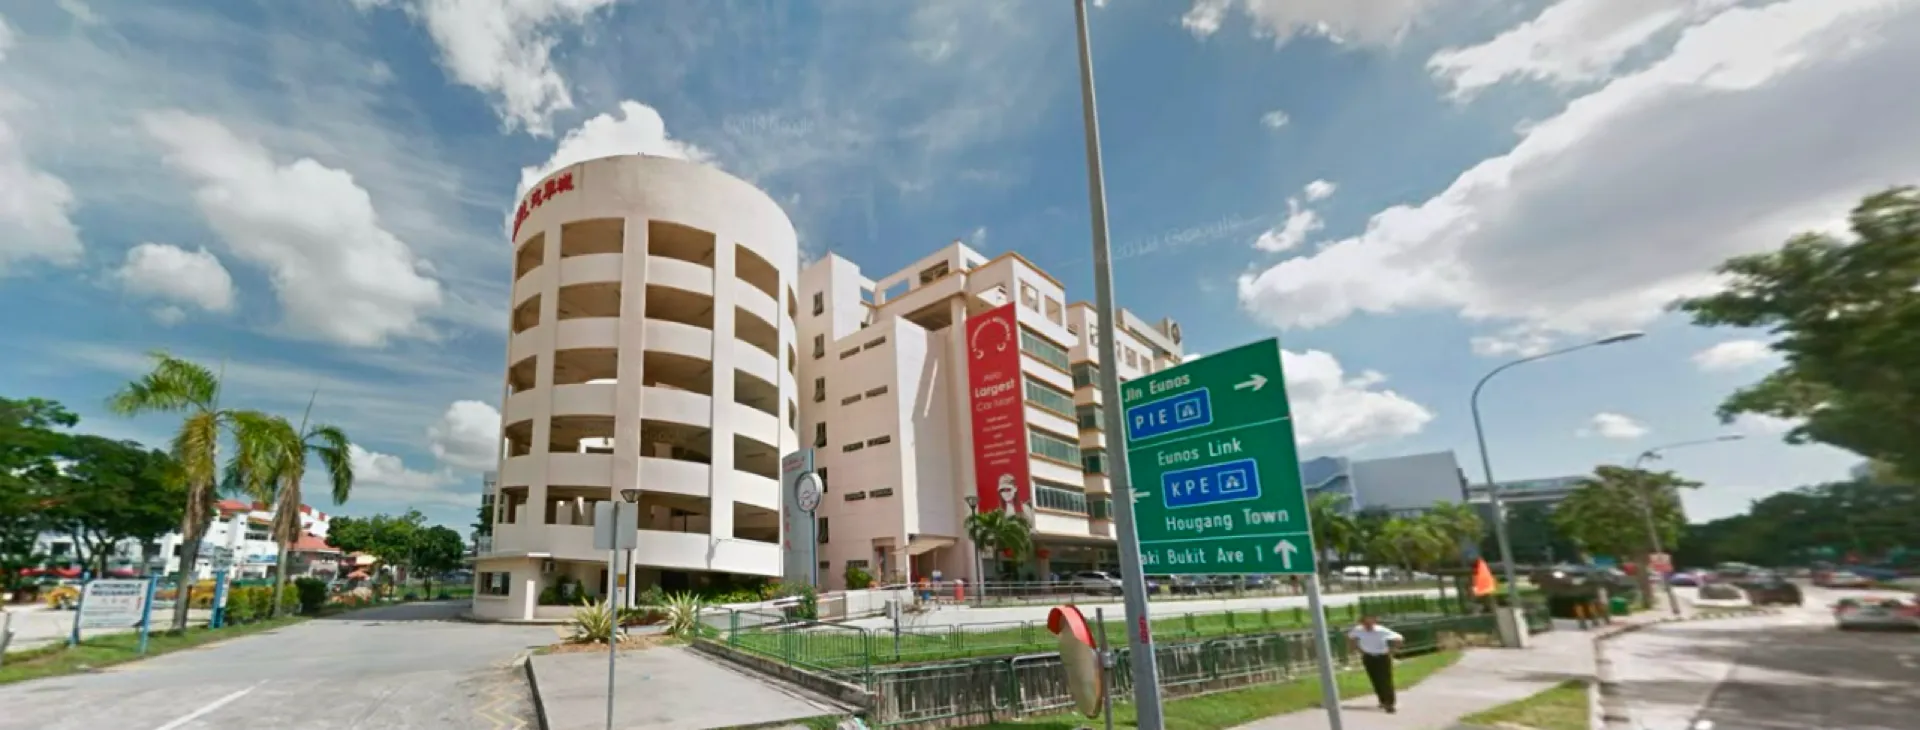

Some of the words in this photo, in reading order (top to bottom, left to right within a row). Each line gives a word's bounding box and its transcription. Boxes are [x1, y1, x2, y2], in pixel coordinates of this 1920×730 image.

[974, 378, 1015, 398] Largest
[1124, 387, 1143, 402] Jln
[1149, 374, 1191, 395] Eunos
[1135, 408, 1168, 430] PIE
[1157, 447, 1200, 467] Eunos
[1208, 437, 1243, 457] Link
[1171, 477, 1210, 498] KPE
[1165, 512, 1234, 533] Hougang
[1242, 507, 1289, 526] Town
[1139, 549, 1160, 565] aki
[1167, 548, 1206, 565] Bukit
[1217, 547, 1244, 563] Ave
[1255, 545, 1263, 561] 1
